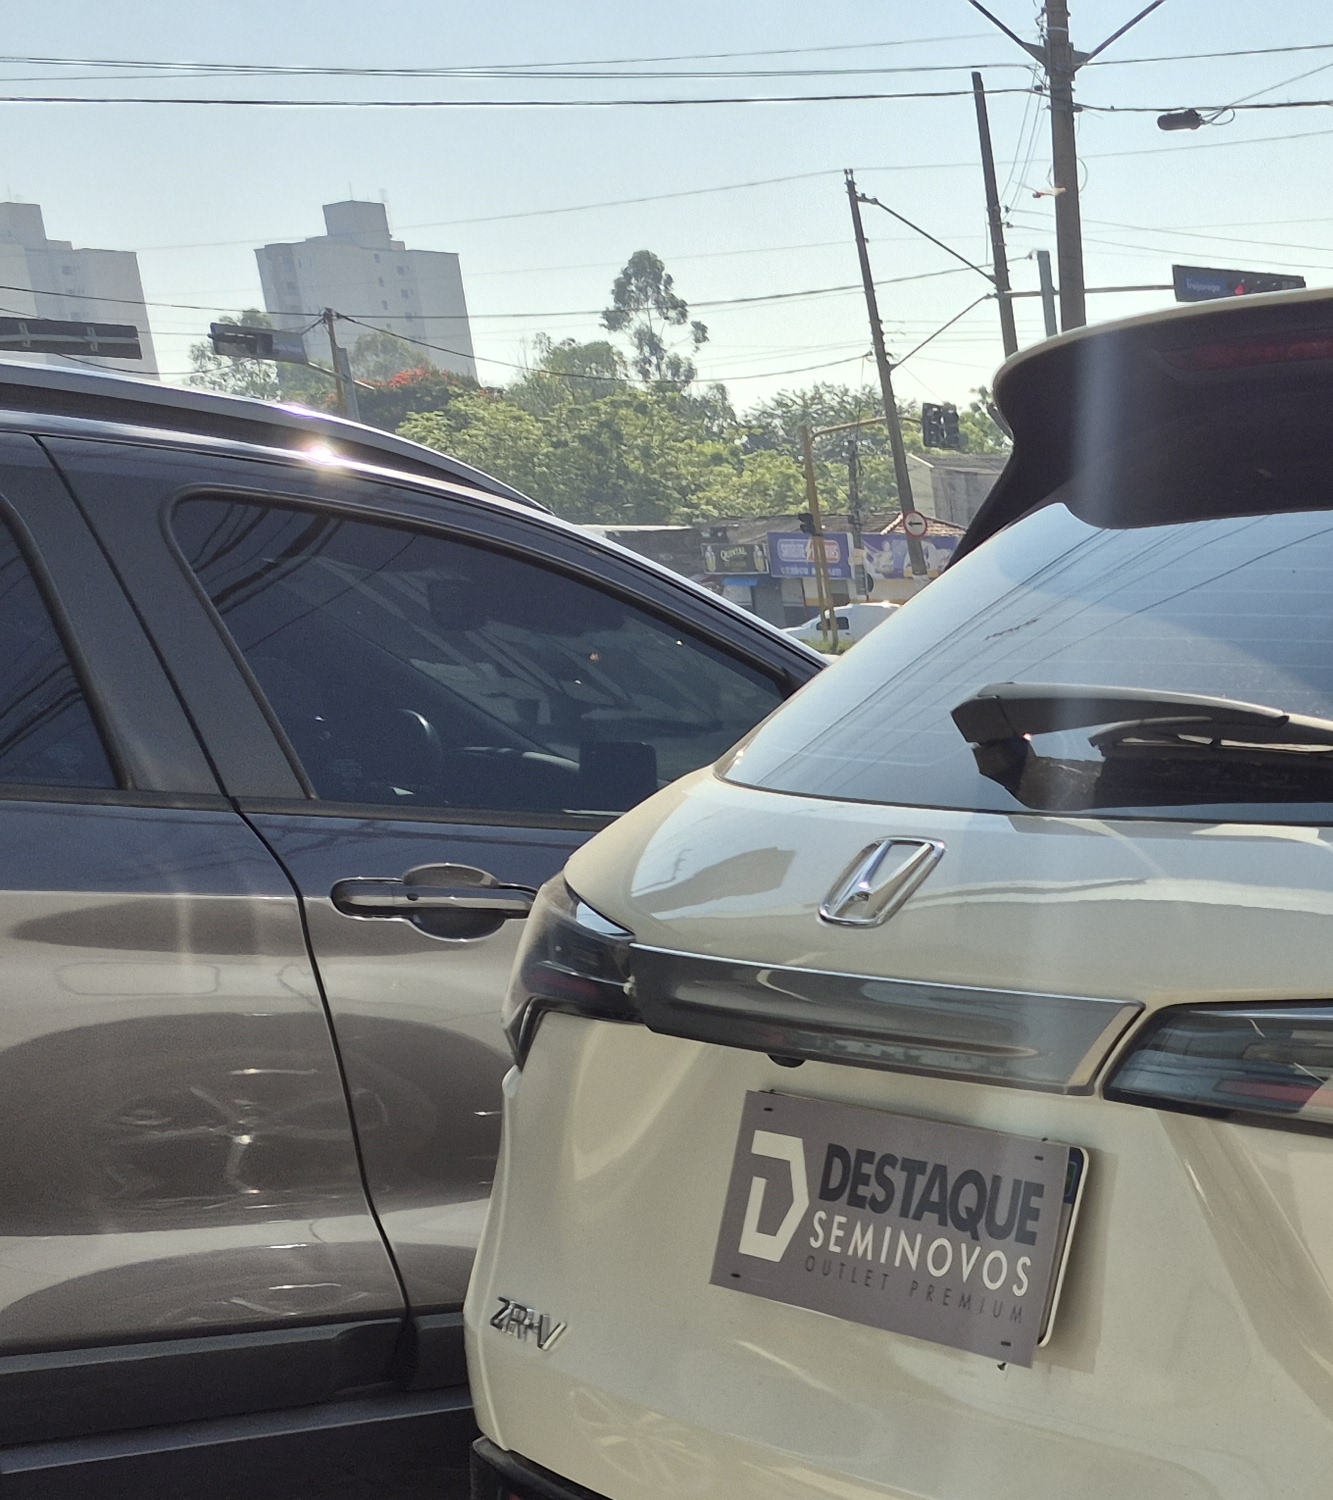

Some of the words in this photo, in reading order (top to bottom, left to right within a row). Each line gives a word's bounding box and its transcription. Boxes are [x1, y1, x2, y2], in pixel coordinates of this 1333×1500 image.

[818, 1142, 1045, 1247] DESTAQUE
[805, 1254, 890, 1291] OUTLET
[909, 1279, 1023, 1324] PREMIUM
[809, 1210, 1032, 1297] SEMINOVOS
